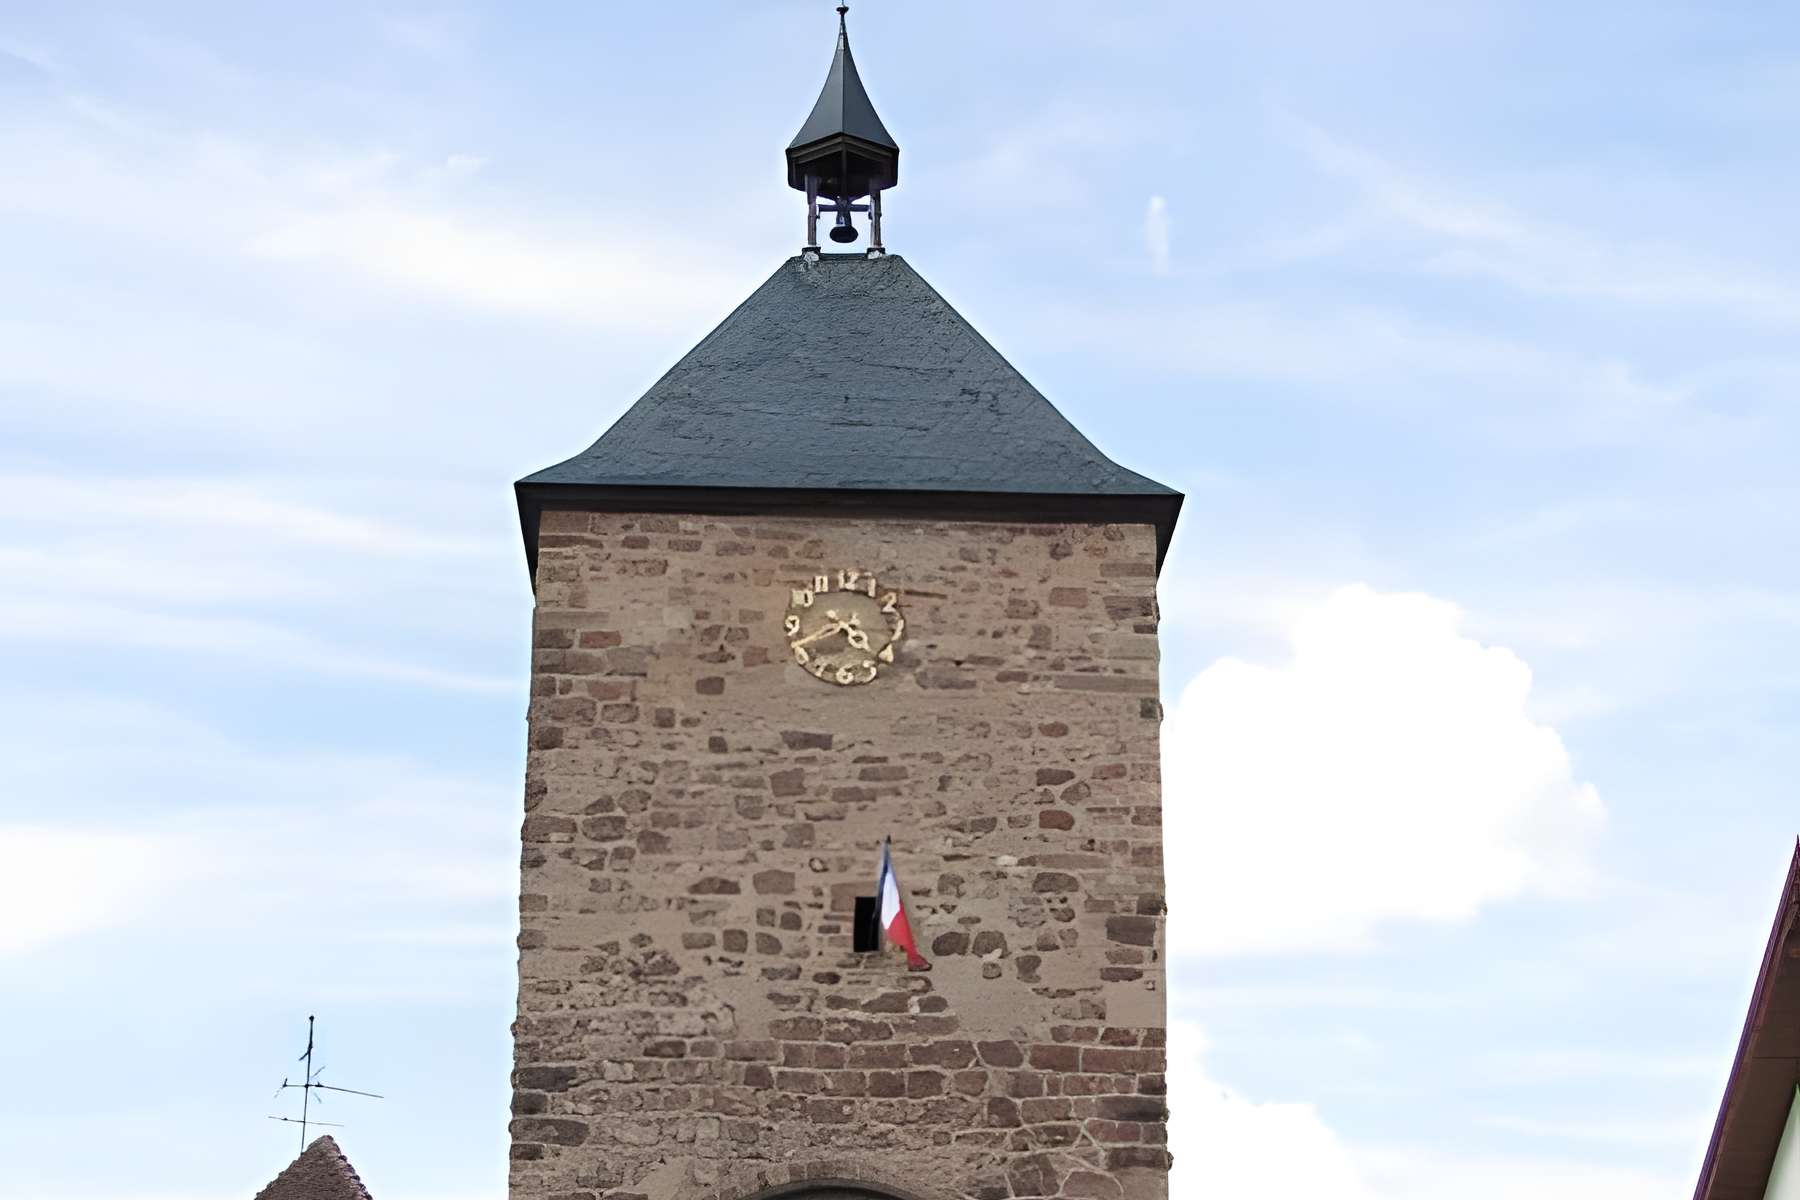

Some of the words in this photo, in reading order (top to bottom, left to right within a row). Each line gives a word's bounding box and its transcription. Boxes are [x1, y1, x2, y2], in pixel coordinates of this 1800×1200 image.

[881, 591, 897, 612] 2
[785, 614, 800, 636] 9
[836, 663, 855, 684] 6
